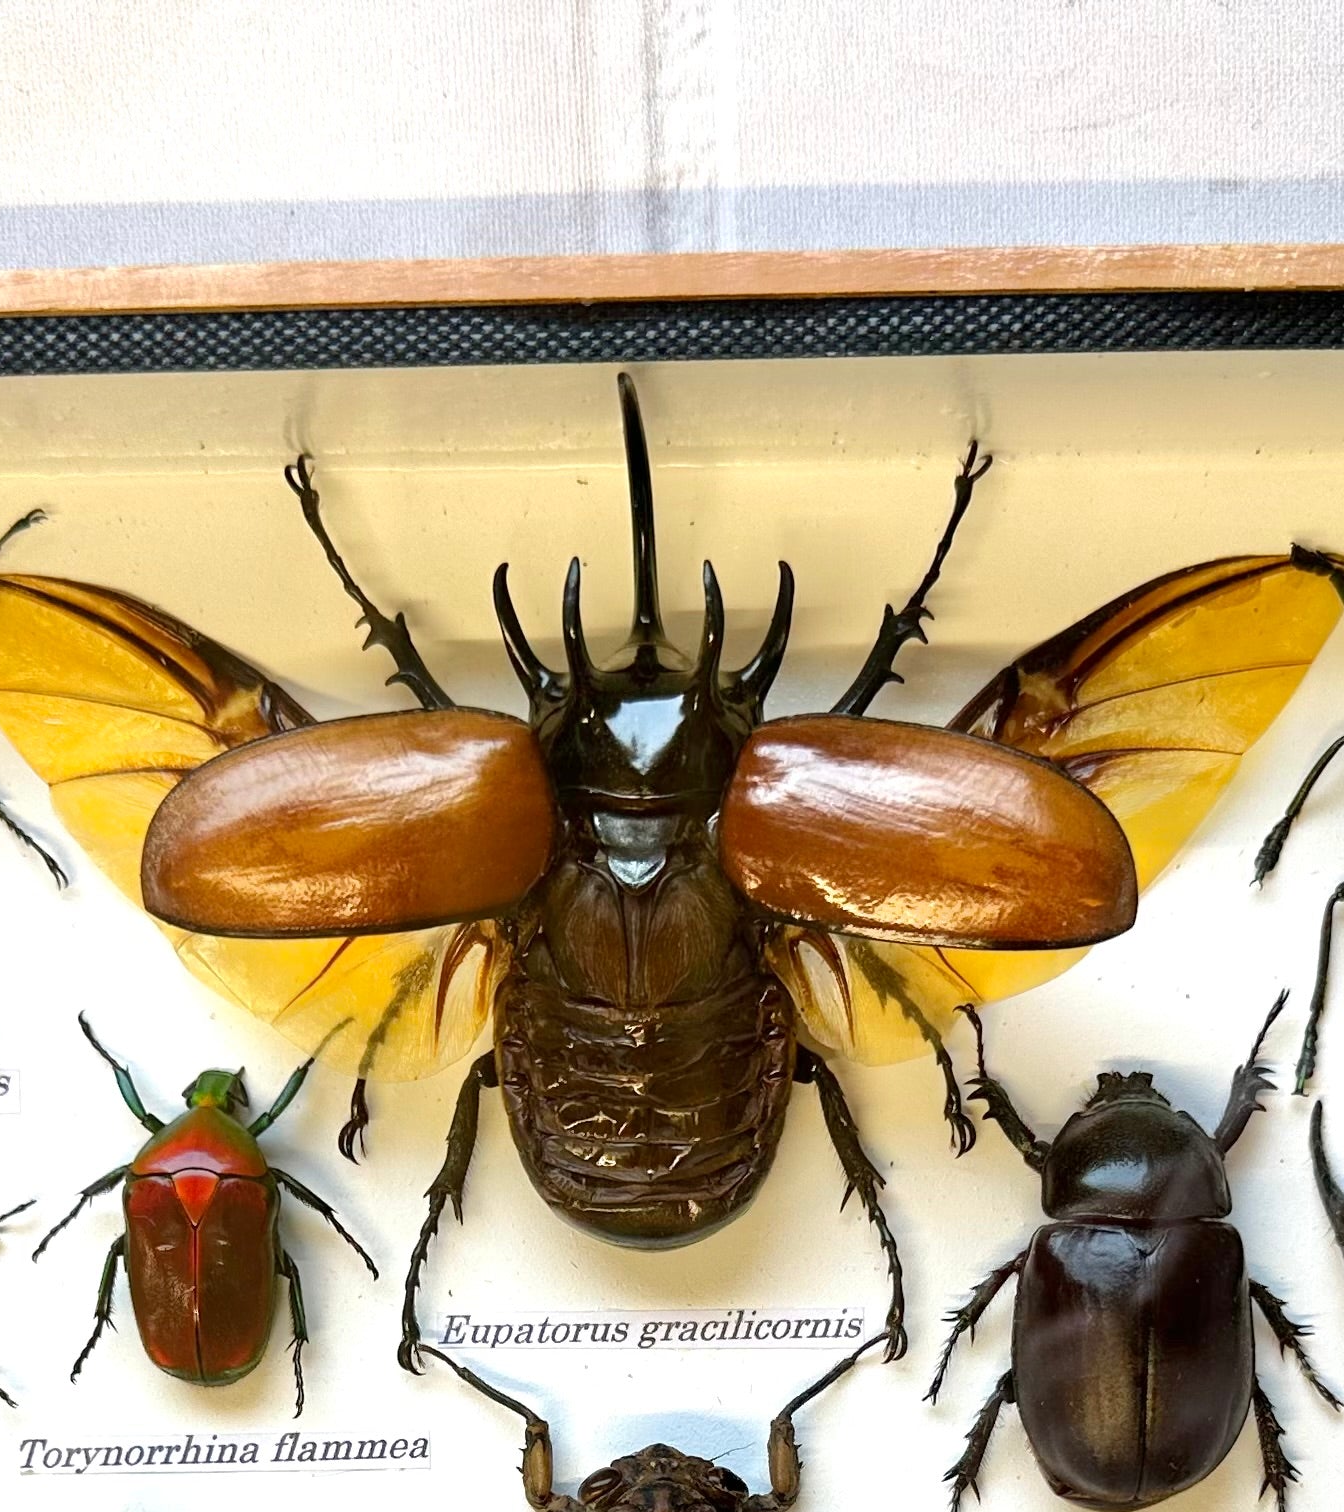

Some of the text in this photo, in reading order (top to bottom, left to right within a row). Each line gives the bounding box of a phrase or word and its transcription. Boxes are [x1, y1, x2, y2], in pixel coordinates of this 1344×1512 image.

[437, 1310, 863, 1348] Eupatorus gracilicornis
[19, 1431, 429, 1474] Torynorrhina flammea
